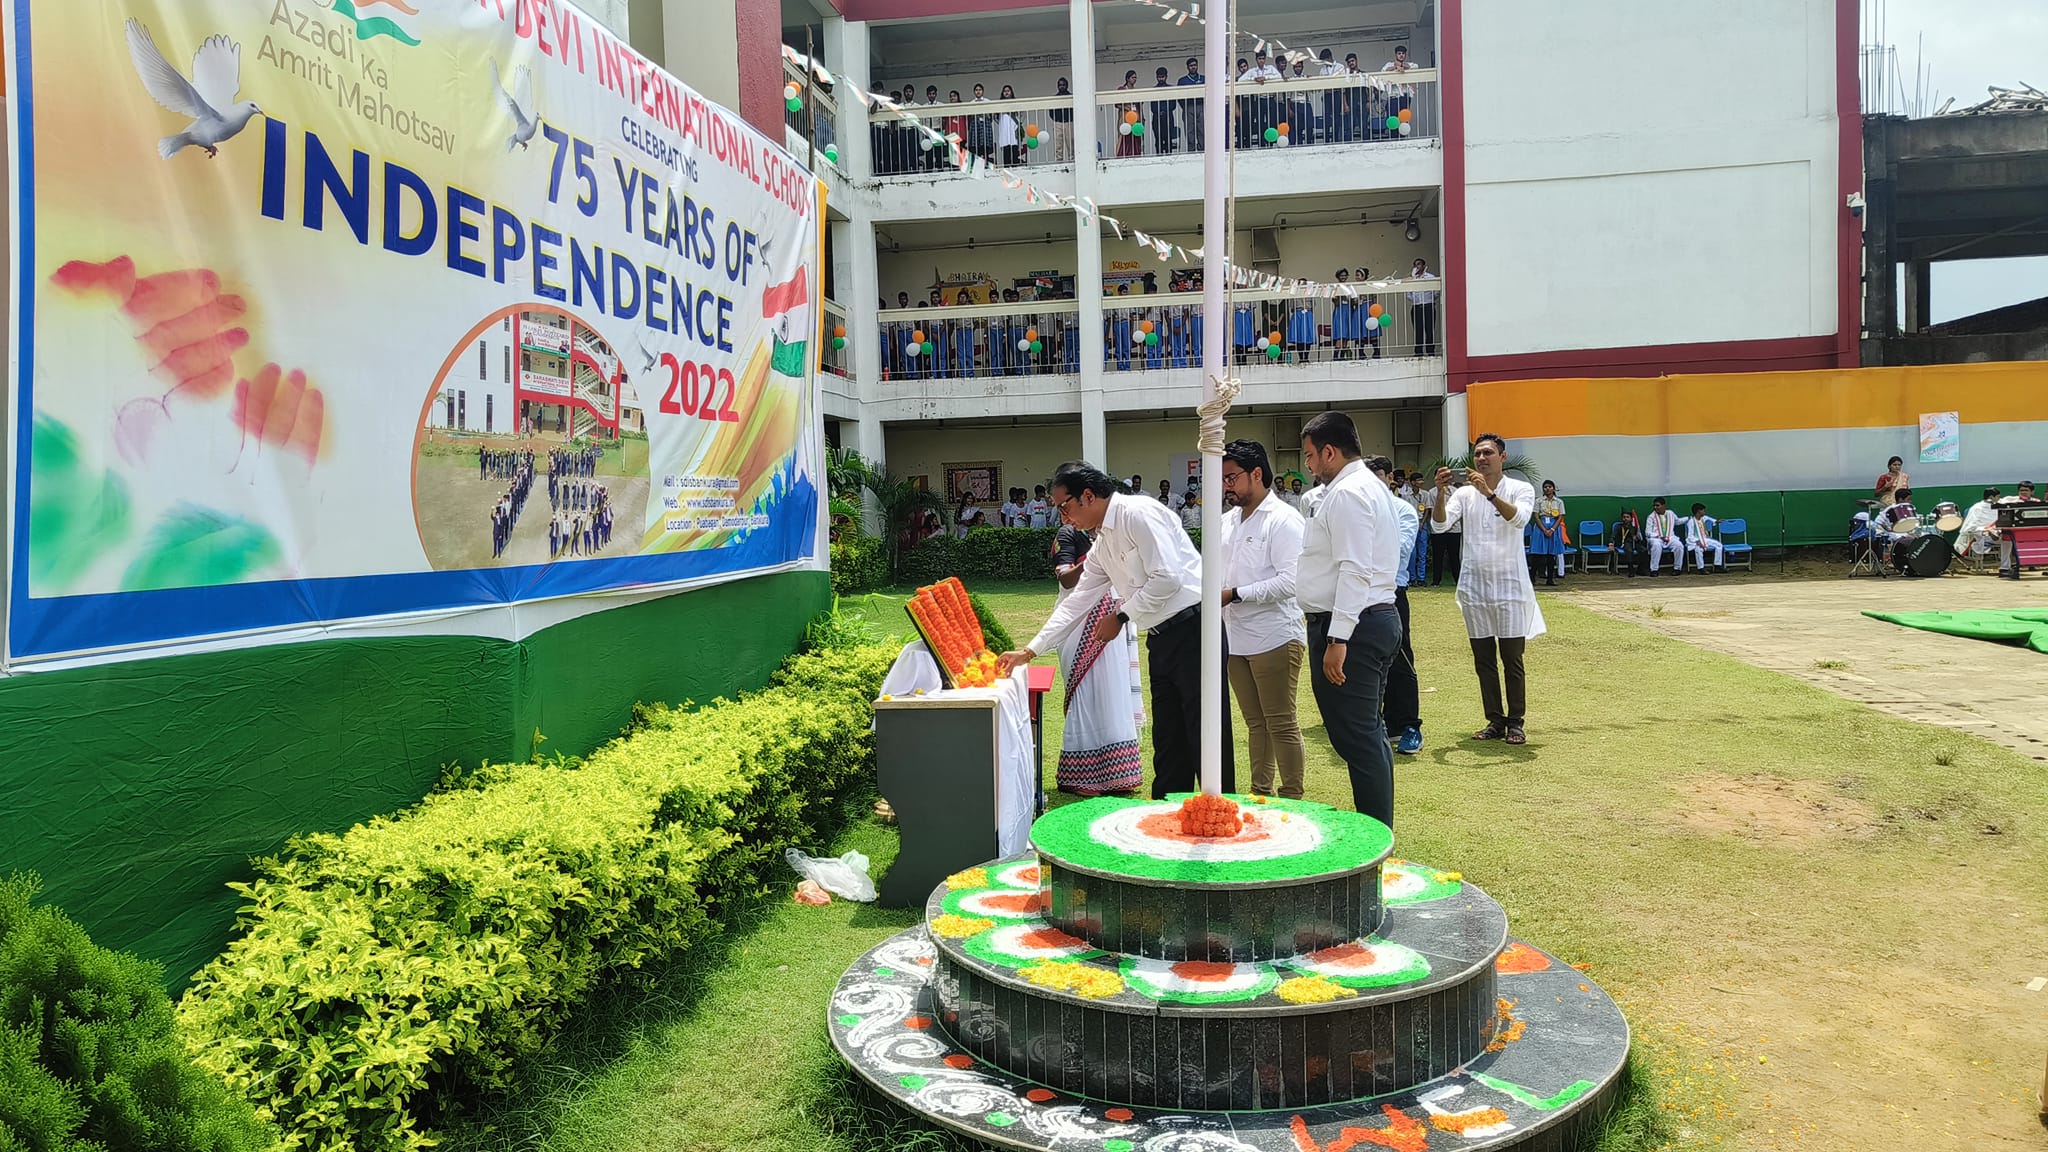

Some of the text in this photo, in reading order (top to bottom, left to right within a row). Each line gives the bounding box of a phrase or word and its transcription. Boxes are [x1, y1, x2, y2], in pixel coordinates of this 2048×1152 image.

[256, 35, 456, 155] Amrit Mahotsav
[269, 0, 389, 90] Azadi Ka
[516, 0, 585, 75] DEVI
[592, 27, 760, 185] INTERNATIONAL
[621, 115, 699, 184] CELEBRATING
[261, 116, 733, 354] INDEPENDENCE
[543, 122, 757, 287] 75 YEARS OF
[659, 351, 740, 423] 2022
[666, 518, 692, 531] Location
